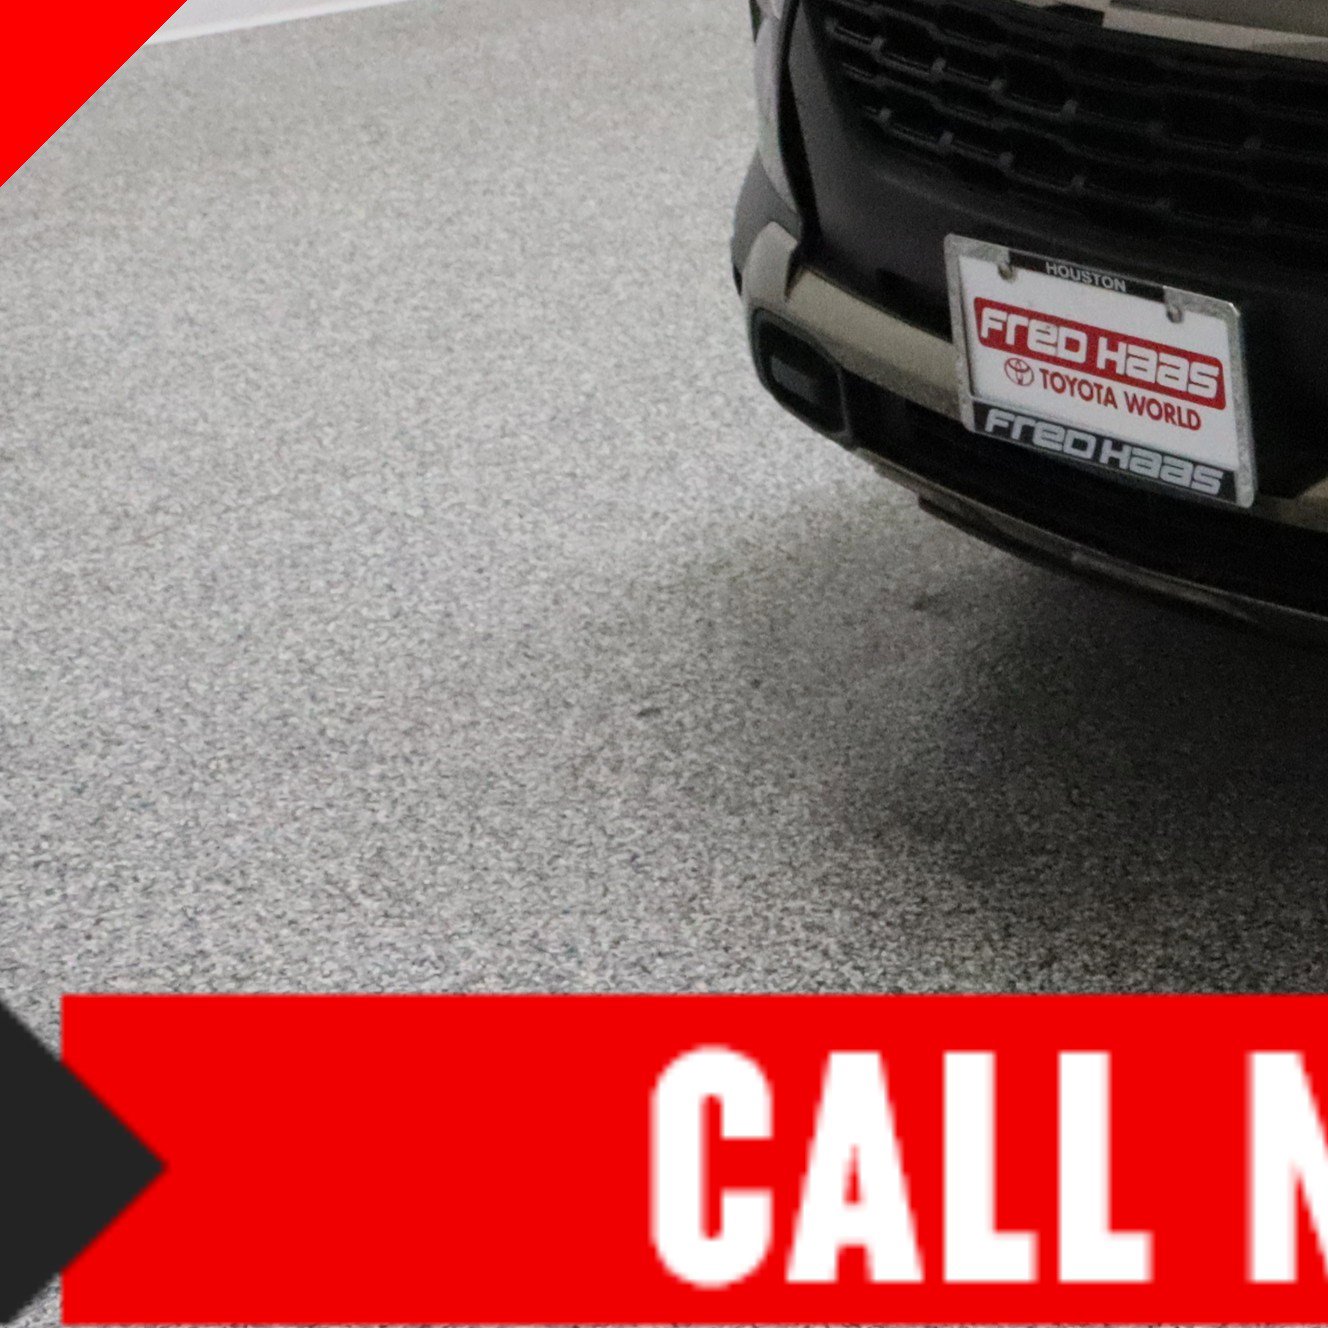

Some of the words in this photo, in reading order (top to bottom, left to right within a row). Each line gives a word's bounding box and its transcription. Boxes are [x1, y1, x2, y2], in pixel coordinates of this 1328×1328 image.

[1045, 261, 1127, 293] HOUSTON
[1038, 367, 1118, 409] TOYOTA
[1124, 390, 1203, 432] WORLD
